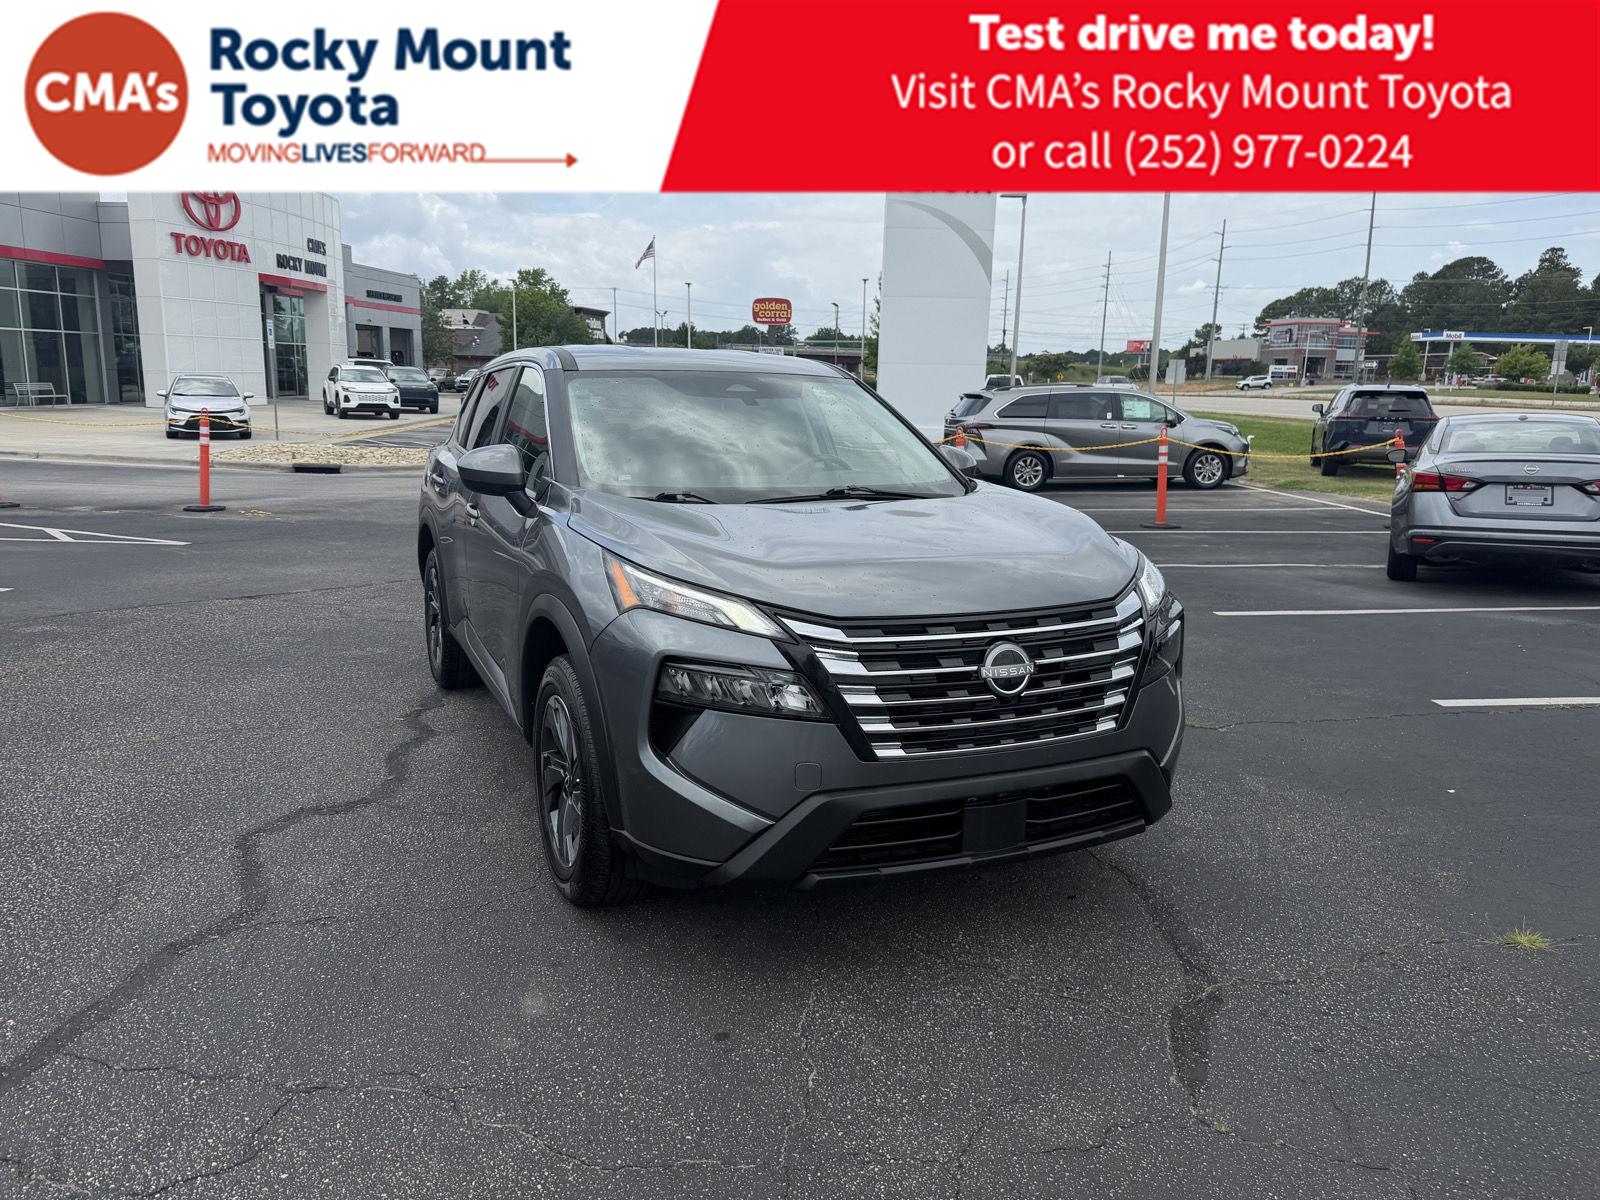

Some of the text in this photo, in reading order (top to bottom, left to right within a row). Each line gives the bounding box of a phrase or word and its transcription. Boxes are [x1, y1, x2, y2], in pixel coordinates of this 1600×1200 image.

[170, 232, 251, 264] TOYOTA
[276, 253, 303, 272] ROCKY
[753, 301, 788, 312] golden
[758, 309, 791, 318] corral
[982, 664, 1034, 677] NISSAN
